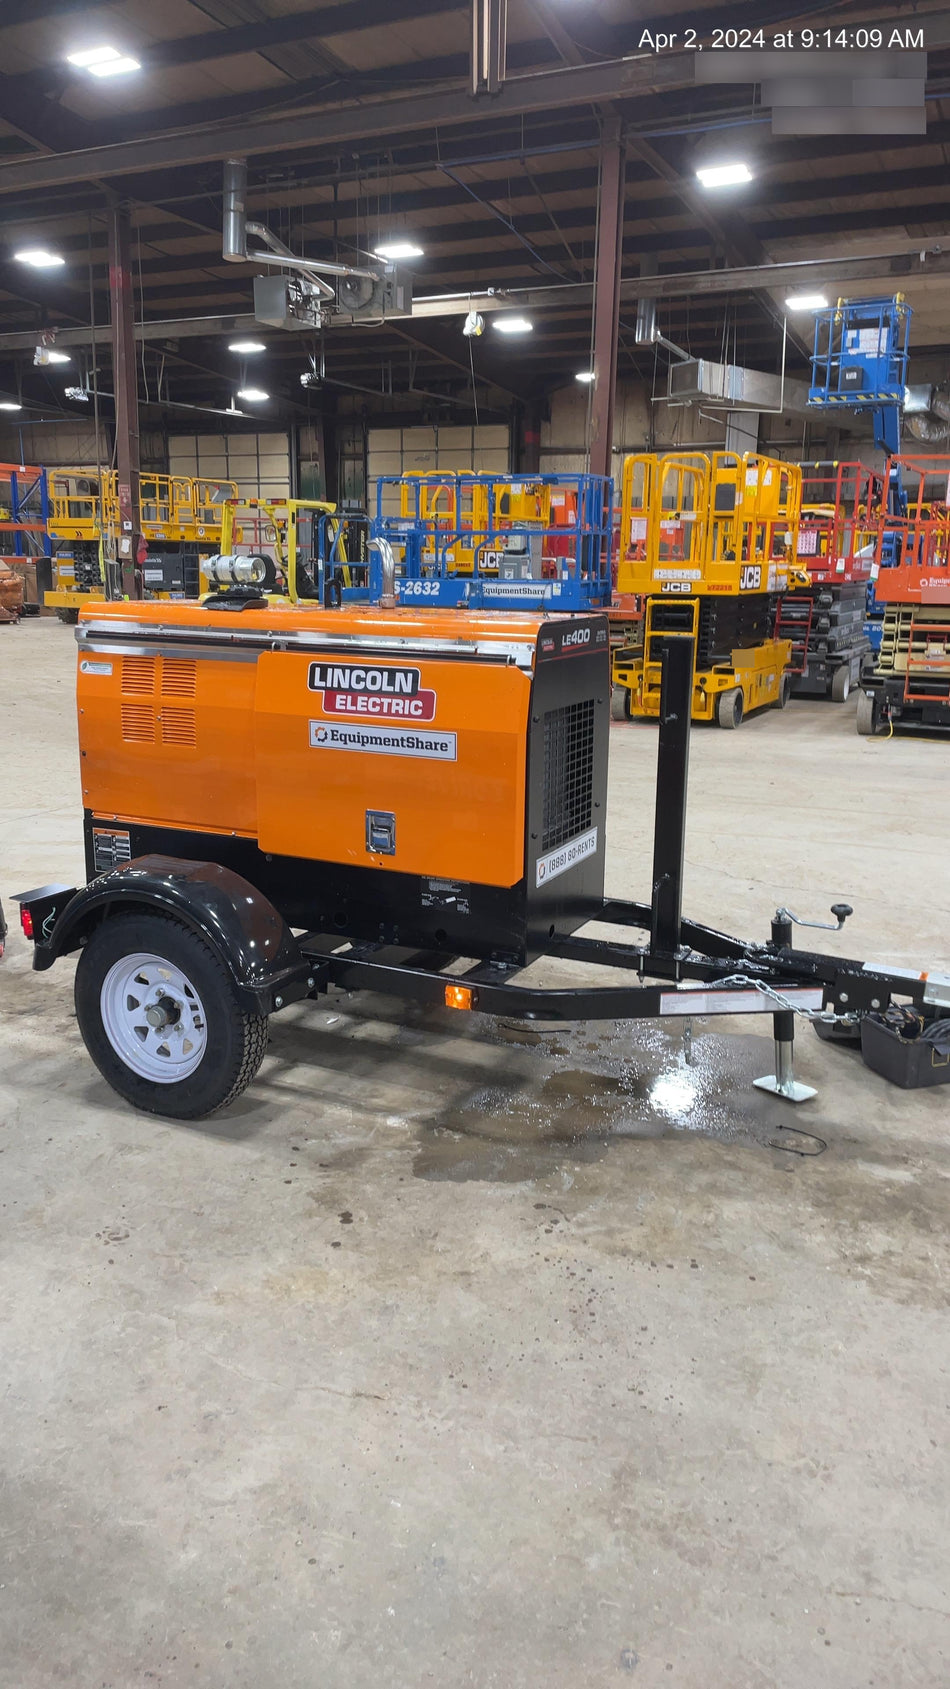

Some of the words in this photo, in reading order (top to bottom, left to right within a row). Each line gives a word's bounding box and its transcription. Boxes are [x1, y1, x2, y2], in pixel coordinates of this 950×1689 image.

[662, 582, 691, 592] JCB
[740, 565, 761, 589] JCB
[562, 628, 591, 646] LE400
[314, 667, 413, 693] LINCOLN
[335, 695, 423, 715] ELECTRIC
[330, 729, 449, 752] EquipmentShare
[549, 852, 567, 873] (888)
